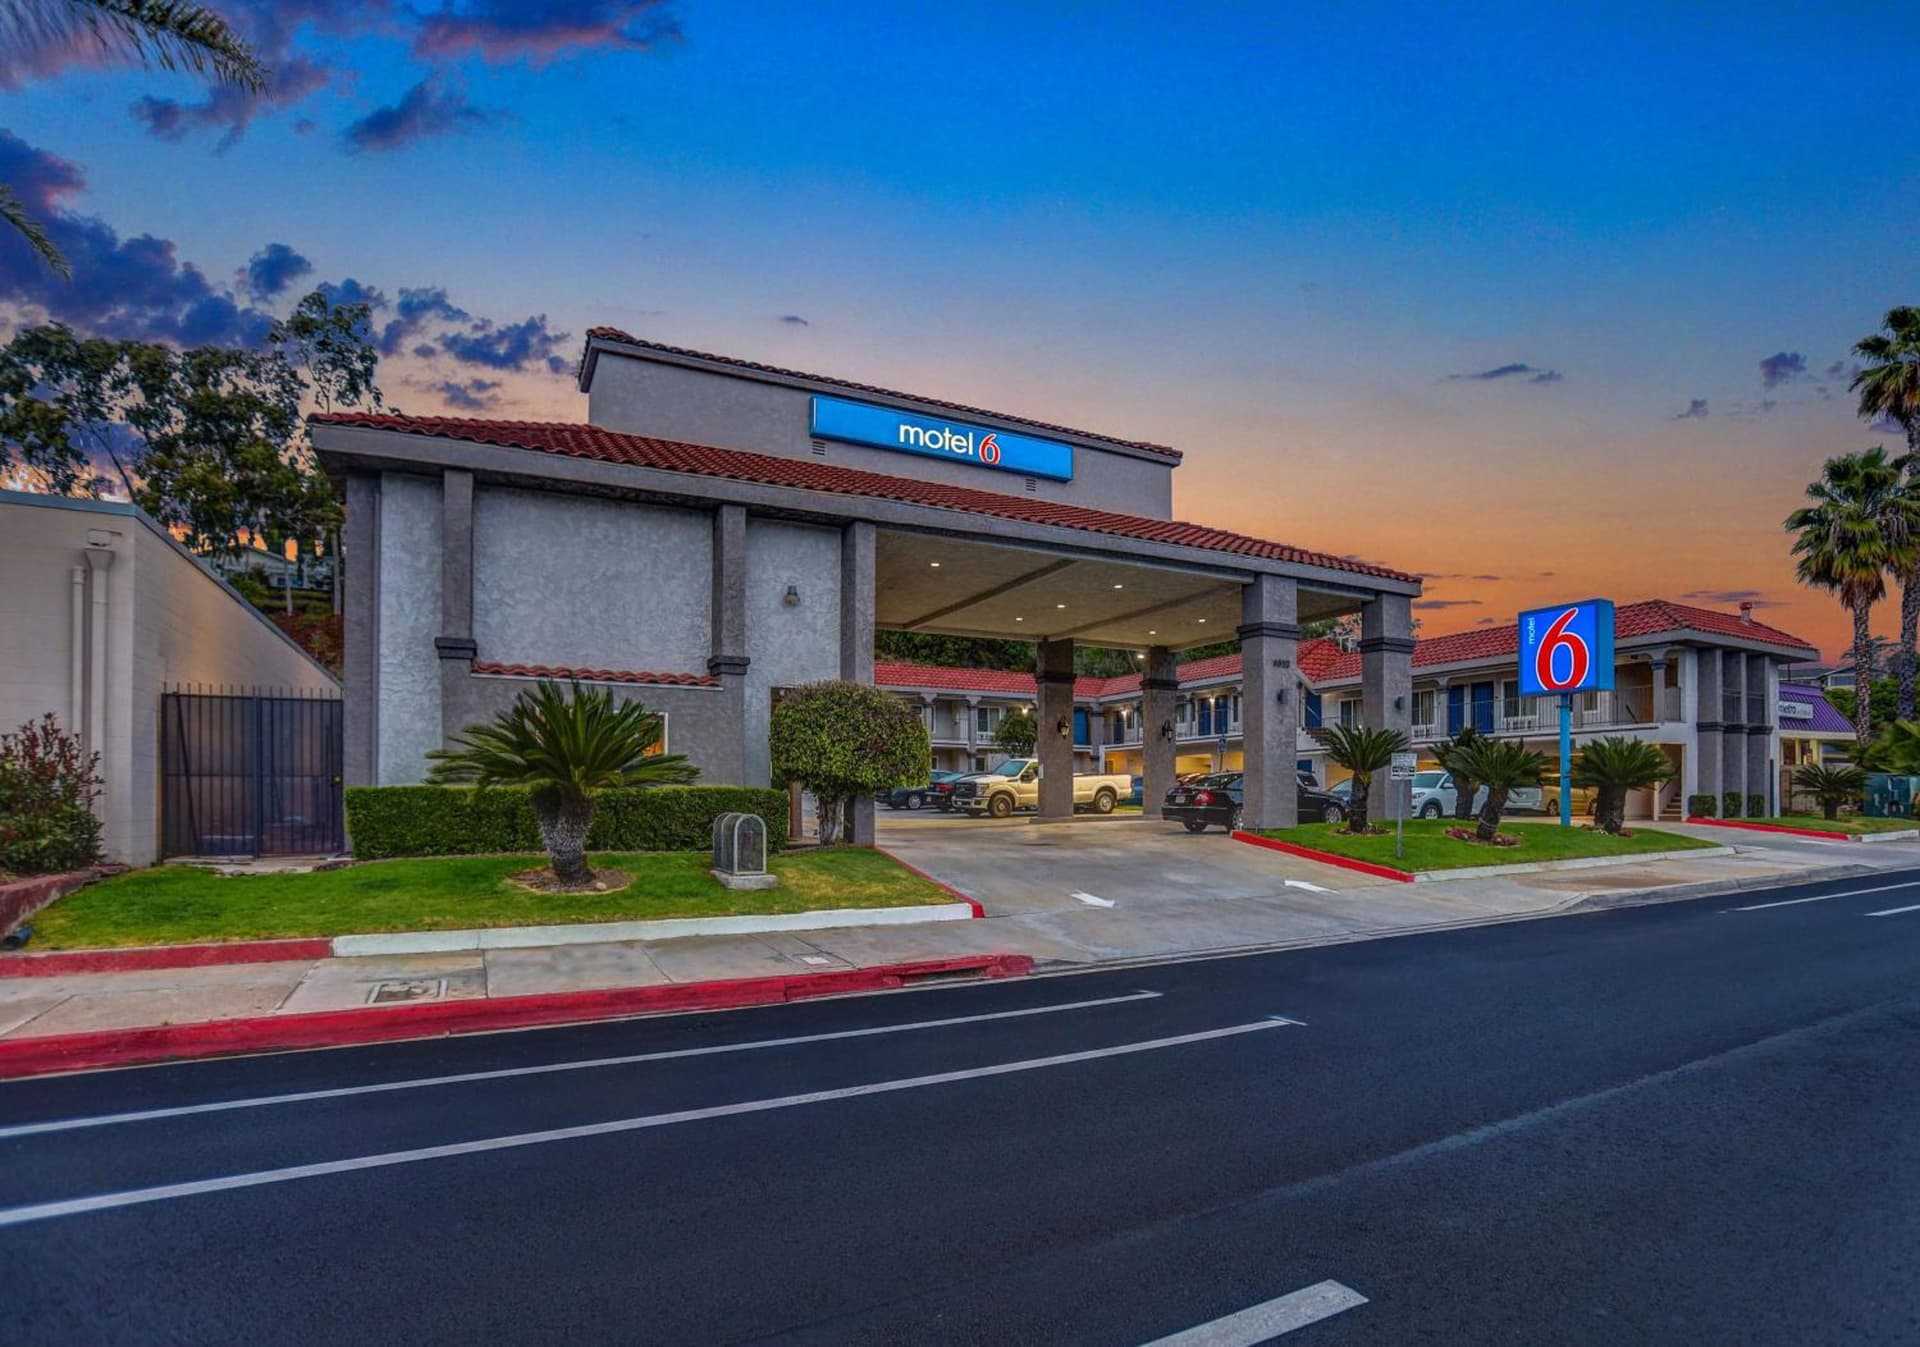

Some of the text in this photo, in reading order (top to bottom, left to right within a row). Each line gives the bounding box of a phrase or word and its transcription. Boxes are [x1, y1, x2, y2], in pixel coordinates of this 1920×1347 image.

[899, 424, 1001, 465] motel 6
[1527, 617, 1536, 645] motel
[1535, 607, 1590, 691] 6
